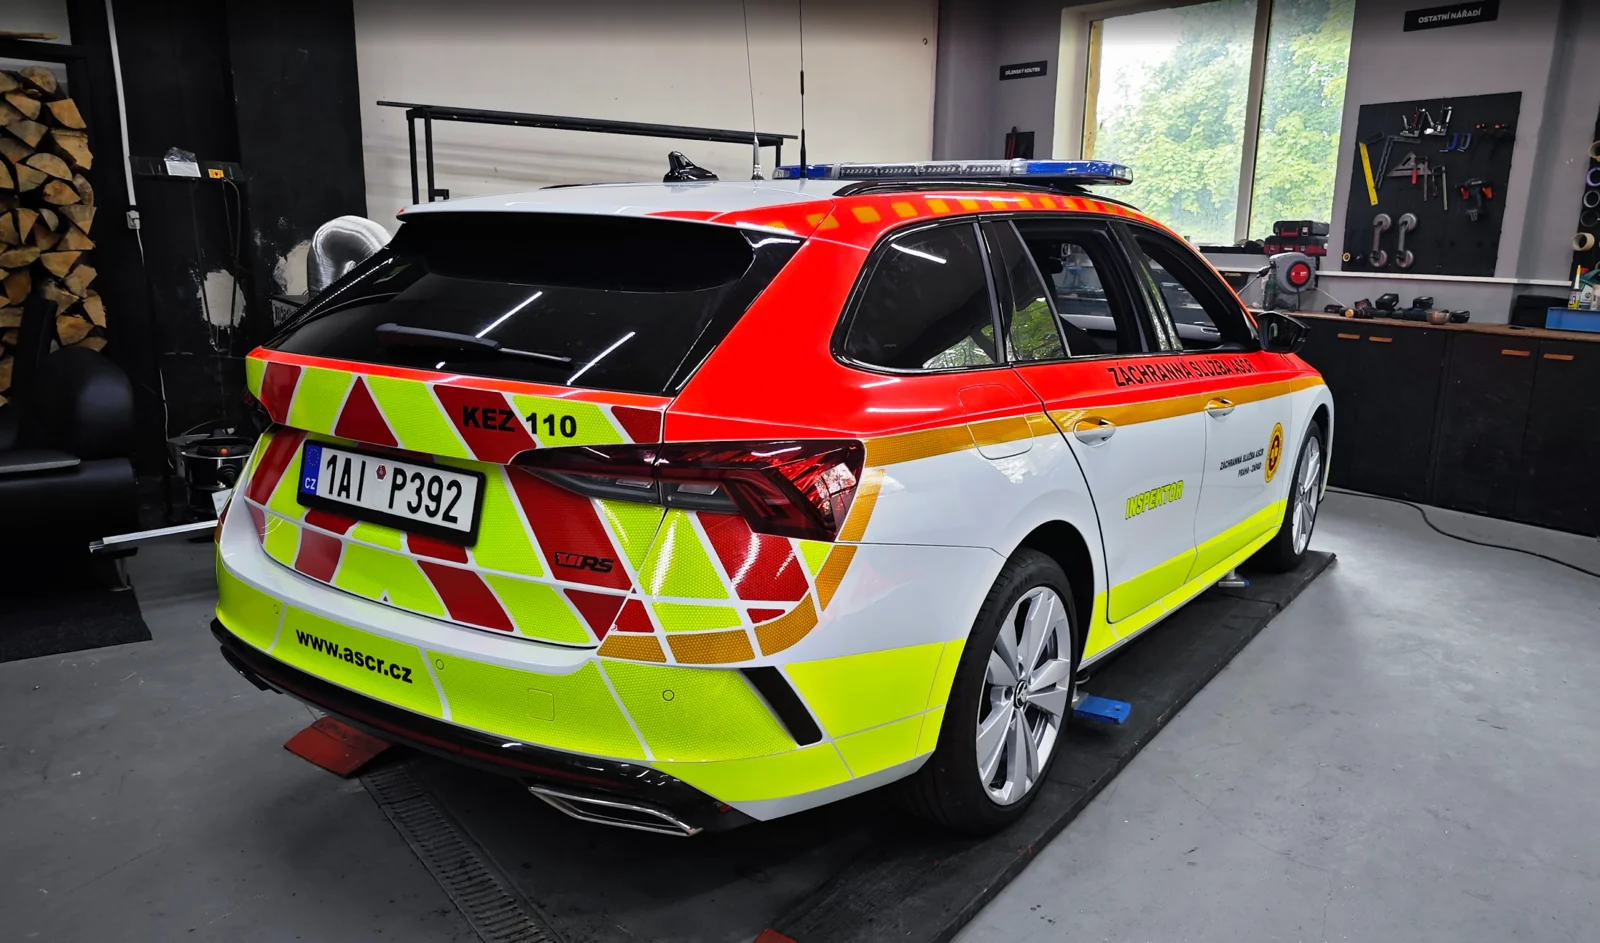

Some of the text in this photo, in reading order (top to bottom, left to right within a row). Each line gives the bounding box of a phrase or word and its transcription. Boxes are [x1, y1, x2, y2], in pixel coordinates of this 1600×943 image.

[1418, 7, 1482, 23] OSTATNÍ NÁŘADÍ
[1107, 358, 1194, 387] ZÁCHRANNÁ
[1189, 357, 1232, 377] SLUŽBA
[462, 405, 577, 438] KEZ 110
[304, 477, 316, 490] CZ
[326, 454, 462, 524] 1AI P392
[1125, 480, 1183, 520] INSPEKTOR
[296, 629, 413, 684] www.ascr.cz
